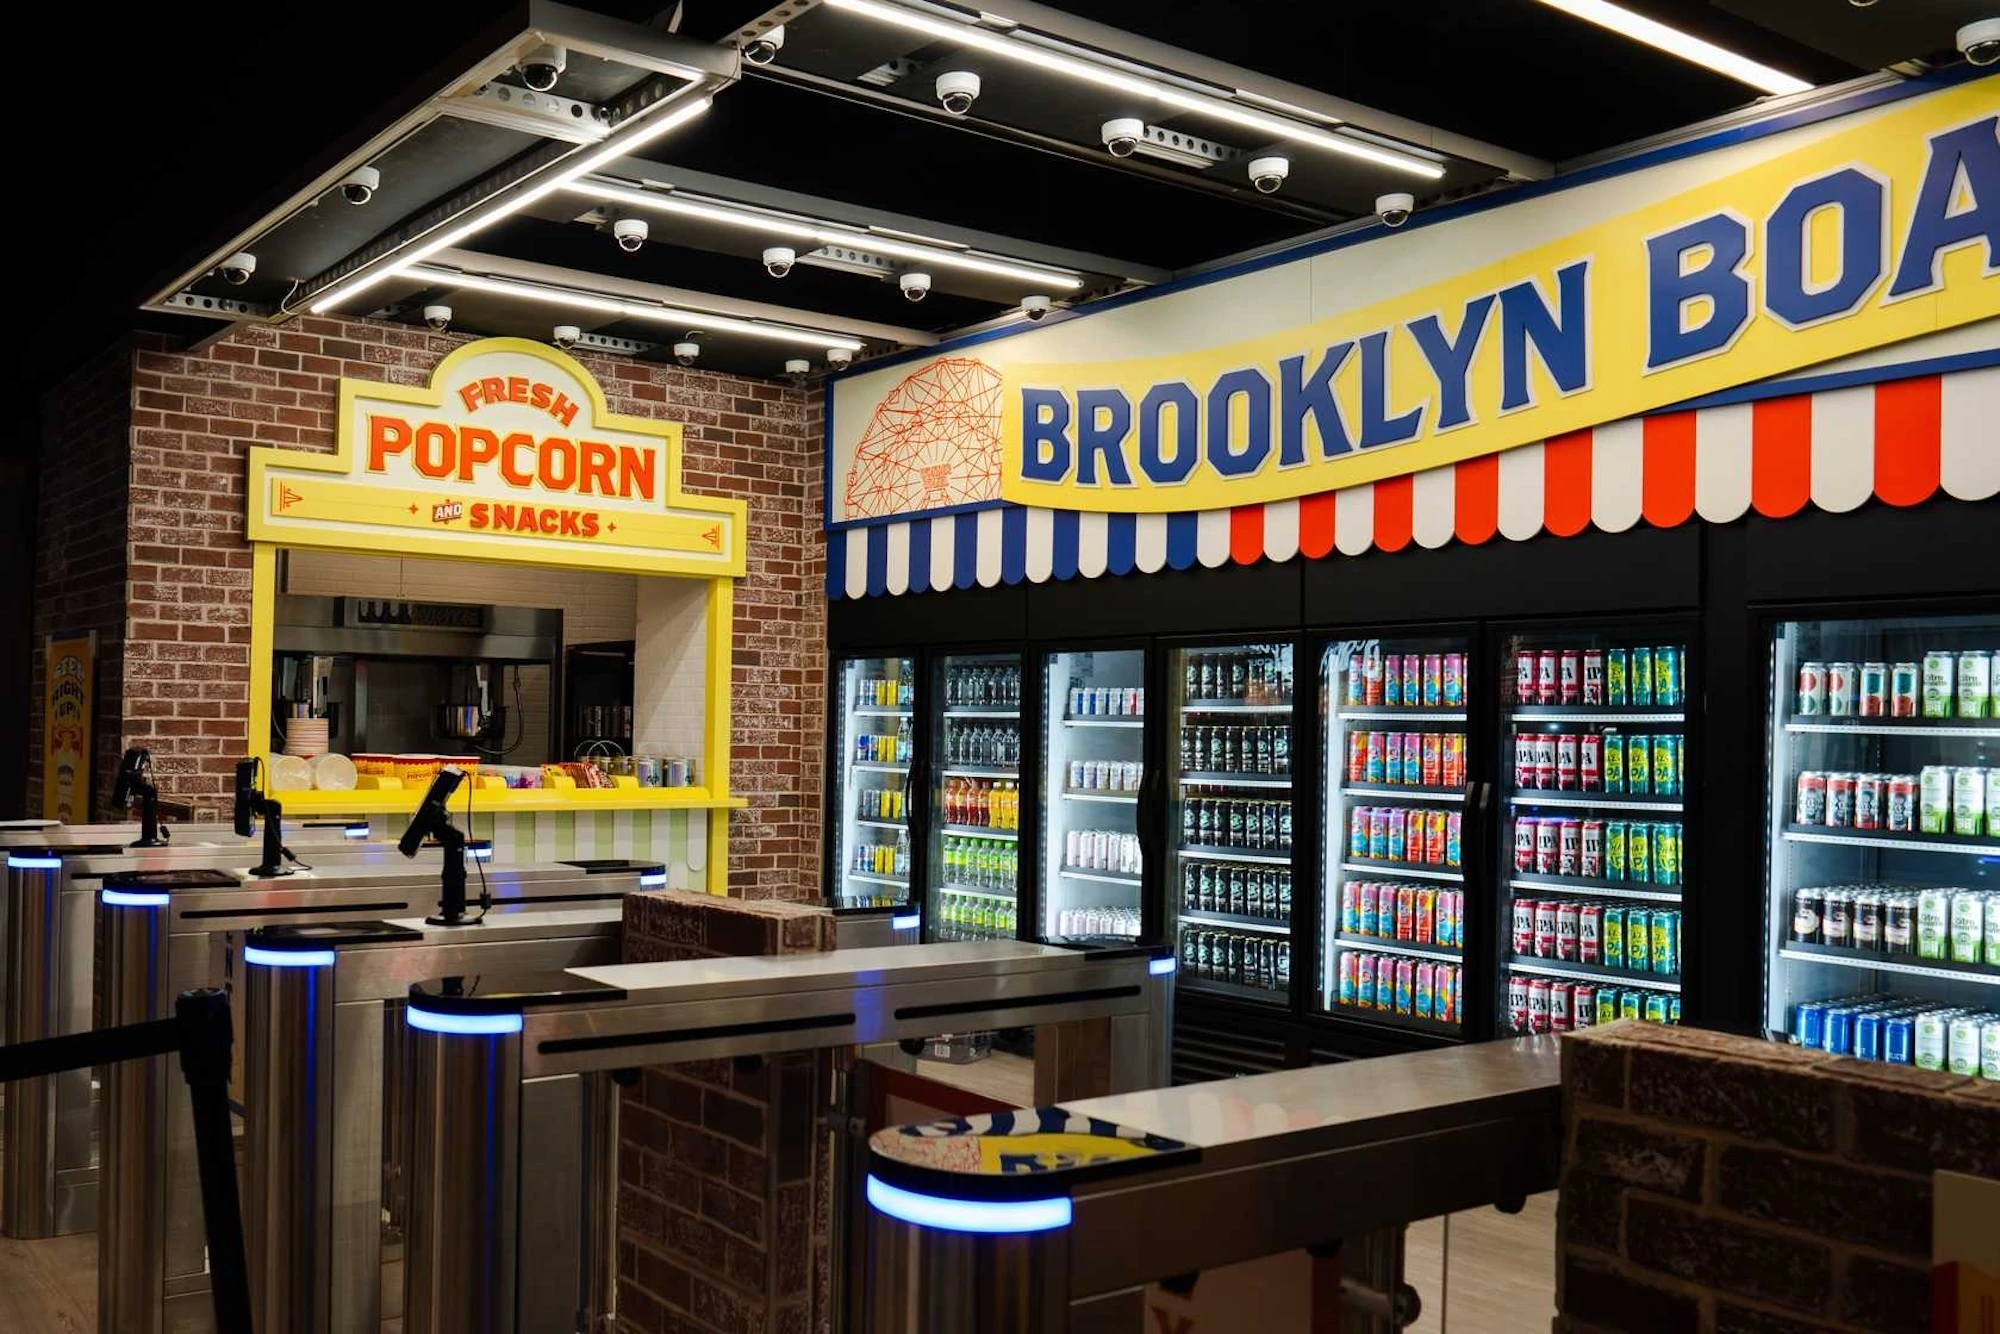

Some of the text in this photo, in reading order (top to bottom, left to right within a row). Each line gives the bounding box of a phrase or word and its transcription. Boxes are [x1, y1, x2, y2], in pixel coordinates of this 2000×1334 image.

[1020, 115, 2000, 485] BROOKLYN BOA
[458, 376, 580, 427] FRESH
[367, 413, 656, 500] POPCORN
[434, 502, 600, 537] AND SNACKS
[1516, 833, 1531, 846] PA
[1515, 915, 1531, 929] PA
[1581, 923, 1595, 937] PA
